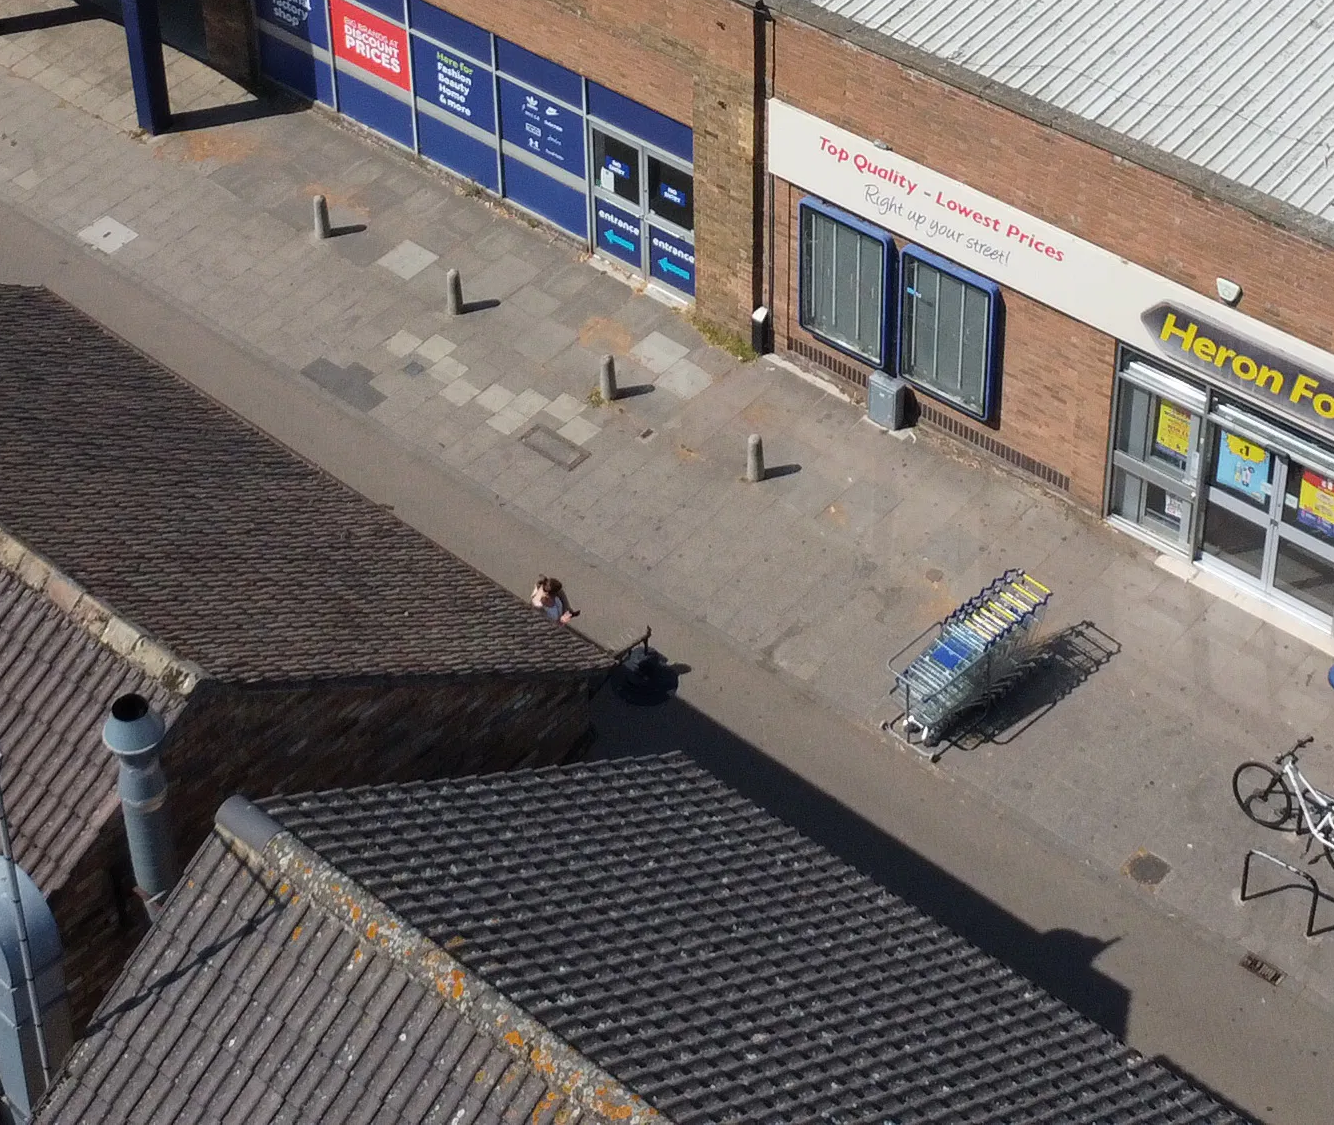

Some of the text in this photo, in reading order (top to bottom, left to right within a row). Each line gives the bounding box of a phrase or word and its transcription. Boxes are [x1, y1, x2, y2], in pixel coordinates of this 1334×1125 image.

[273, 7, 300, 27] shop
[344, 24, 400, 59] DISCOUNT
[346, 36, 401, 74] PRICES
[436, 51, 474, 76] Here for
[437, 61, 472, 86] Fashion
[438, 72, 470, 96] Beauty
[438, 82, 466, 103] Home
[447, 98, 472, 117] more
[820, 136, 850, 164] Top
[853, 153, 918, 196] Quality
[935, 191, 1002, 233] Lowest
[1006, 224, 1065, 262] Prices
[598, 210, 641, 236] entrance
[864, 183, 1012, 267] Right up your street!
[652, 237, 696, 264] entrance
[1159, 313, 1285, 396] Heron
